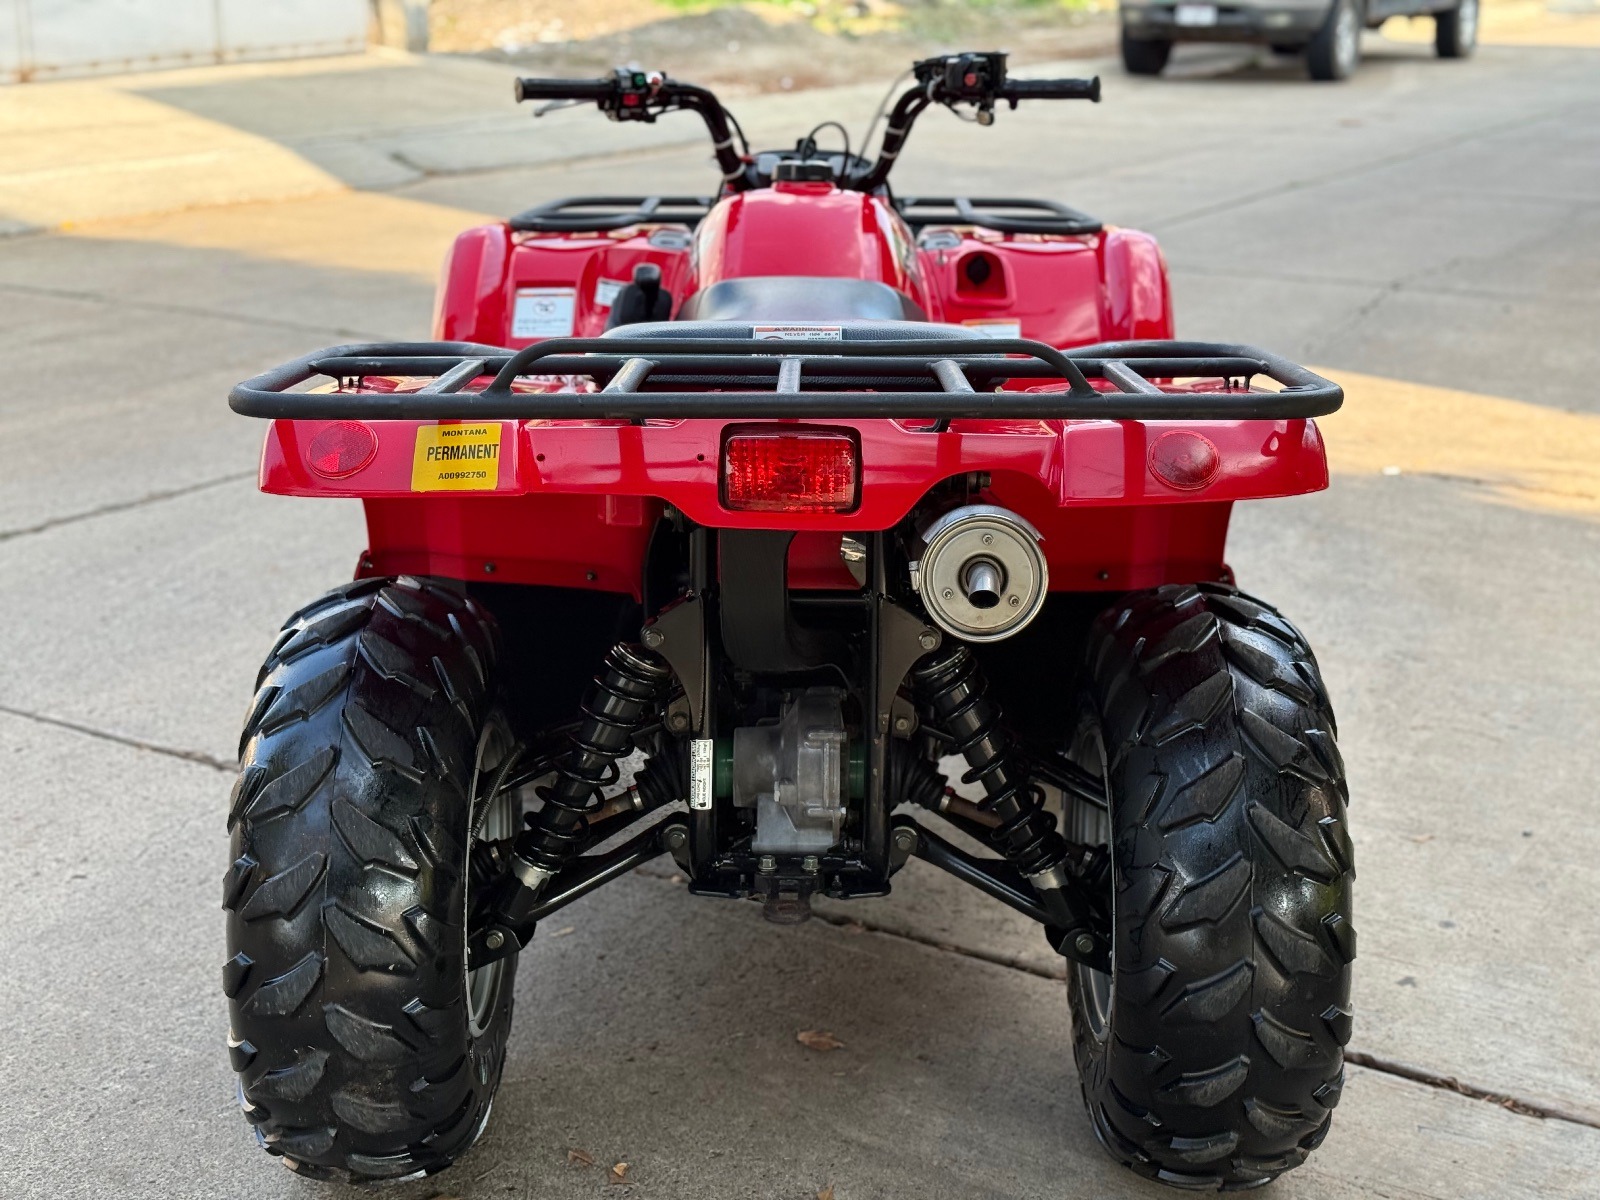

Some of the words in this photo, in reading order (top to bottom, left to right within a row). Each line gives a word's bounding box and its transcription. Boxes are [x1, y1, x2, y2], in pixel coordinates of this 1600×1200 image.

[442, 429, 487, 437] MONTANA
[427, 444, 499, 461] PERMANENT
[438, 471, 487, 480] A00992750
